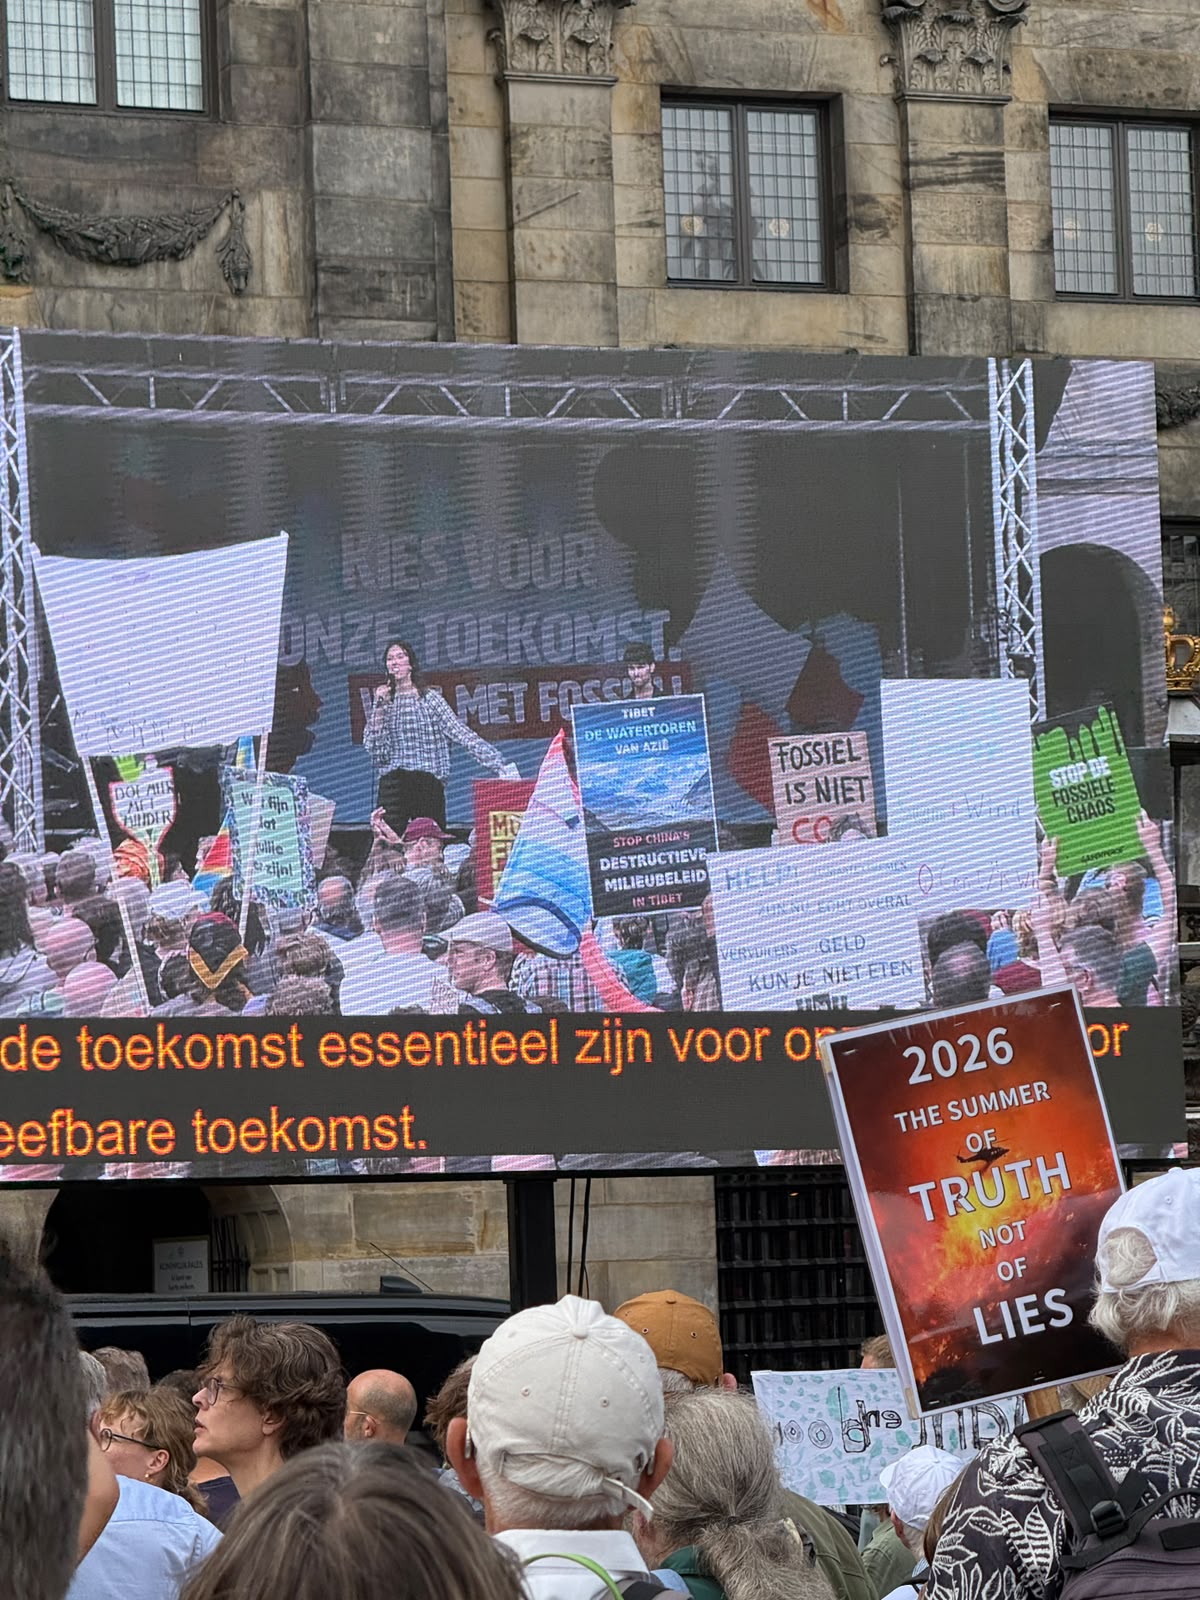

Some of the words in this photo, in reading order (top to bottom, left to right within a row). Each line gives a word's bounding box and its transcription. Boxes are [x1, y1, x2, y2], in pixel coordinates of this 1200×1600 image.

[461, 531, 597, 591] VOOR
[455, 682, 529, 725] MET
[621, 706, 656, 719] TIBET
[585, 728, 602, 742] DE
[606, 720, 697, 740] WATERTOREN
[615, 743, 639, 755] VAN
[771, 737, 862, 772] FOSSIEL
[1049, 761, 1087, 788] STOP
[1087, 755, 1112, 779] DE
[784, 782, 807, 804] IS
[815, 775, 869, 805] NIET
[1052, 776, 1116, 808] FOSSIELE
[1066, 796, 1116, 824] CHAOS
[613, 834, 642, 848] STOP
[646, 830, 690, 845] CHINA'S
[600, 848, 706, 871] DESTRUCTIEVE
[604, 869, 708, 892] MILIEUBELEID
[632, 897, 646, 908] IN
[648, 892, 683, 907] TIBET
[818, 934, 866, 954] GELD
[749, 971, 789, 993] KUN
[793, 969, 815, 990] JE
[822, 964, 863, 985] NIET
[867, 959, 913, 980] ETEN
[0, 1023, 61, 1072] de
[75, 1022, 305, 1071] toekomst
[318, 1017, 559, 1068] essentieel
[574, 1016, 653, 1076] zijn
[666, 1026, 773, 1063] voor
[902, 1026, 1014, 1085] 2026
[894, 1104, 944, 1133] THE
[947, 1080, 1051, 1121] SUMMER
[190, 1103, 428, 1153] toekomst.
[965, 1128, 997, 1154] OF
[908, 1151, 1072, 1222] TRUTH
[977, 1219, 1027, 1250] NOT
[996, 1256, 1028, 1282] OF
[972, 1287, 1075, 1346] LIES
